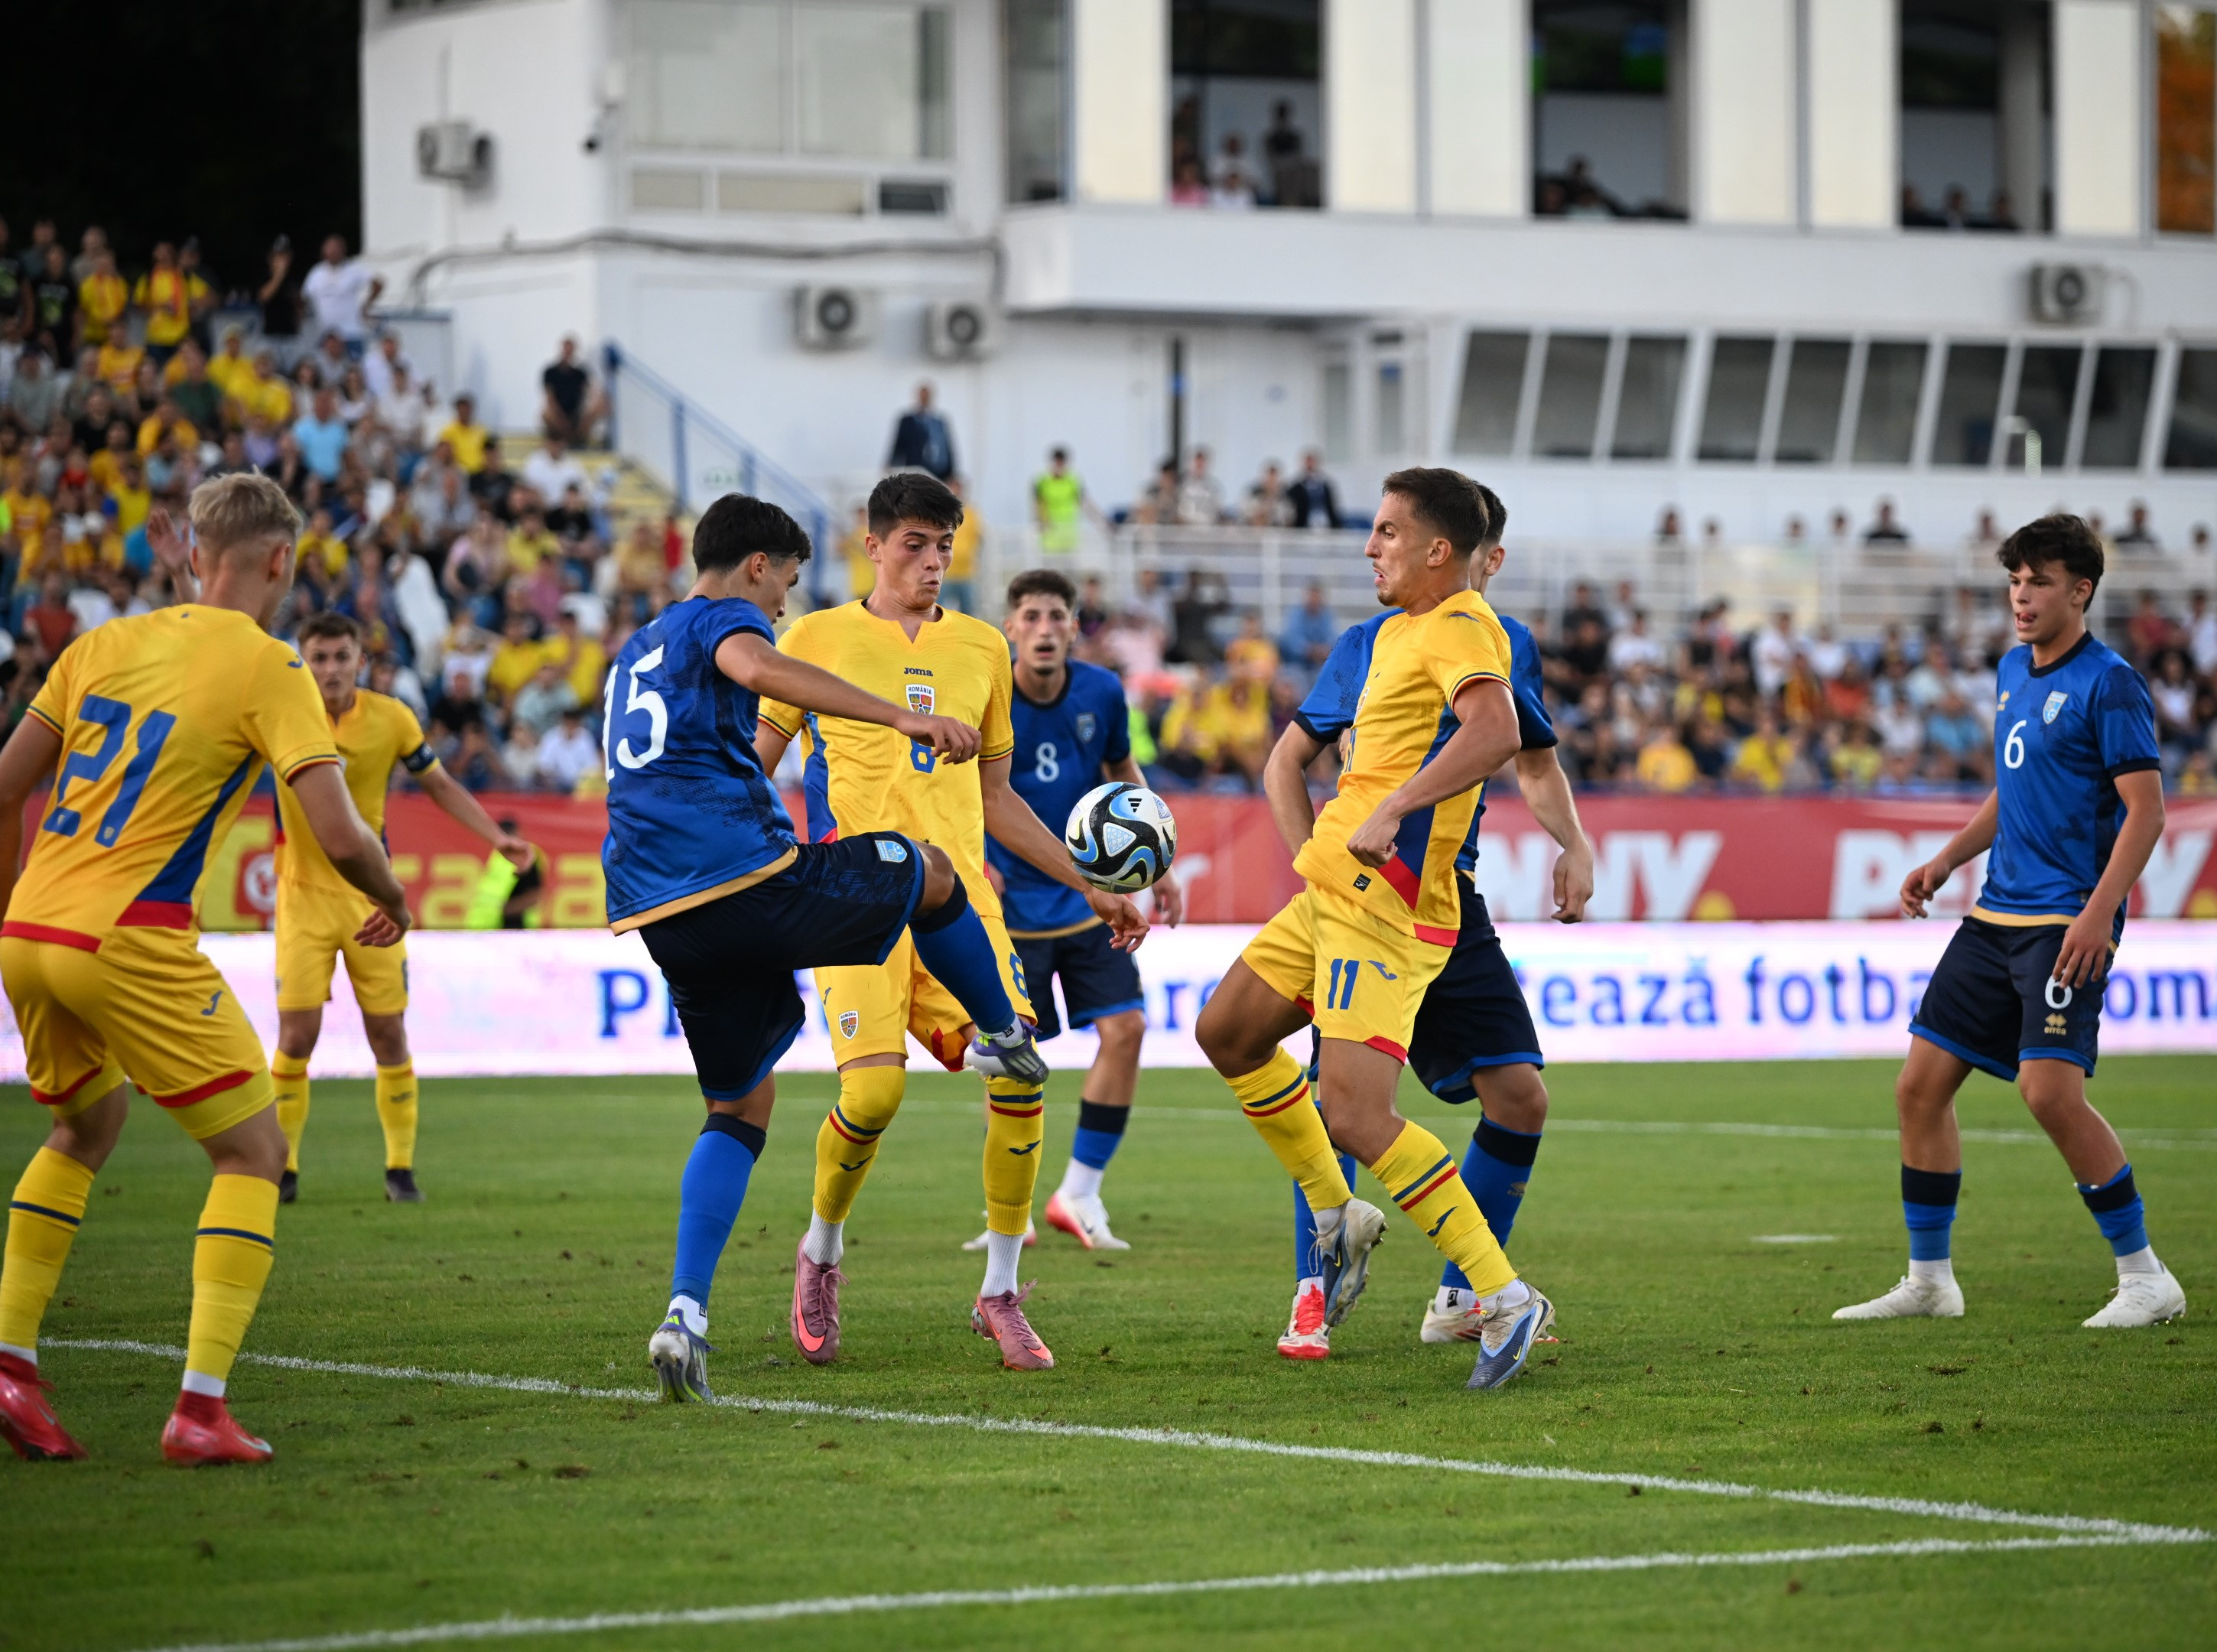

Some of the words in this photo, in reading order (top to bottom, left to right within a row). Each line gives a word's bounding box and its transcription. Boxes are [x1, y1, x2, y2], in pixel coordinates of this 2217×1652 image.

[602, 643, 668, 784] 15
[1035, 741, 1060, 784] 8
[2004, 719, 2027, 769] 6
[43, 693, 177, 849] 21
[1327, 958, 1360, 1010] 11
[1513, 956, 1718, 1026] ează
[2103, 970, 2209, 1021] om
[2044, 967, 2073, 1010] 6
